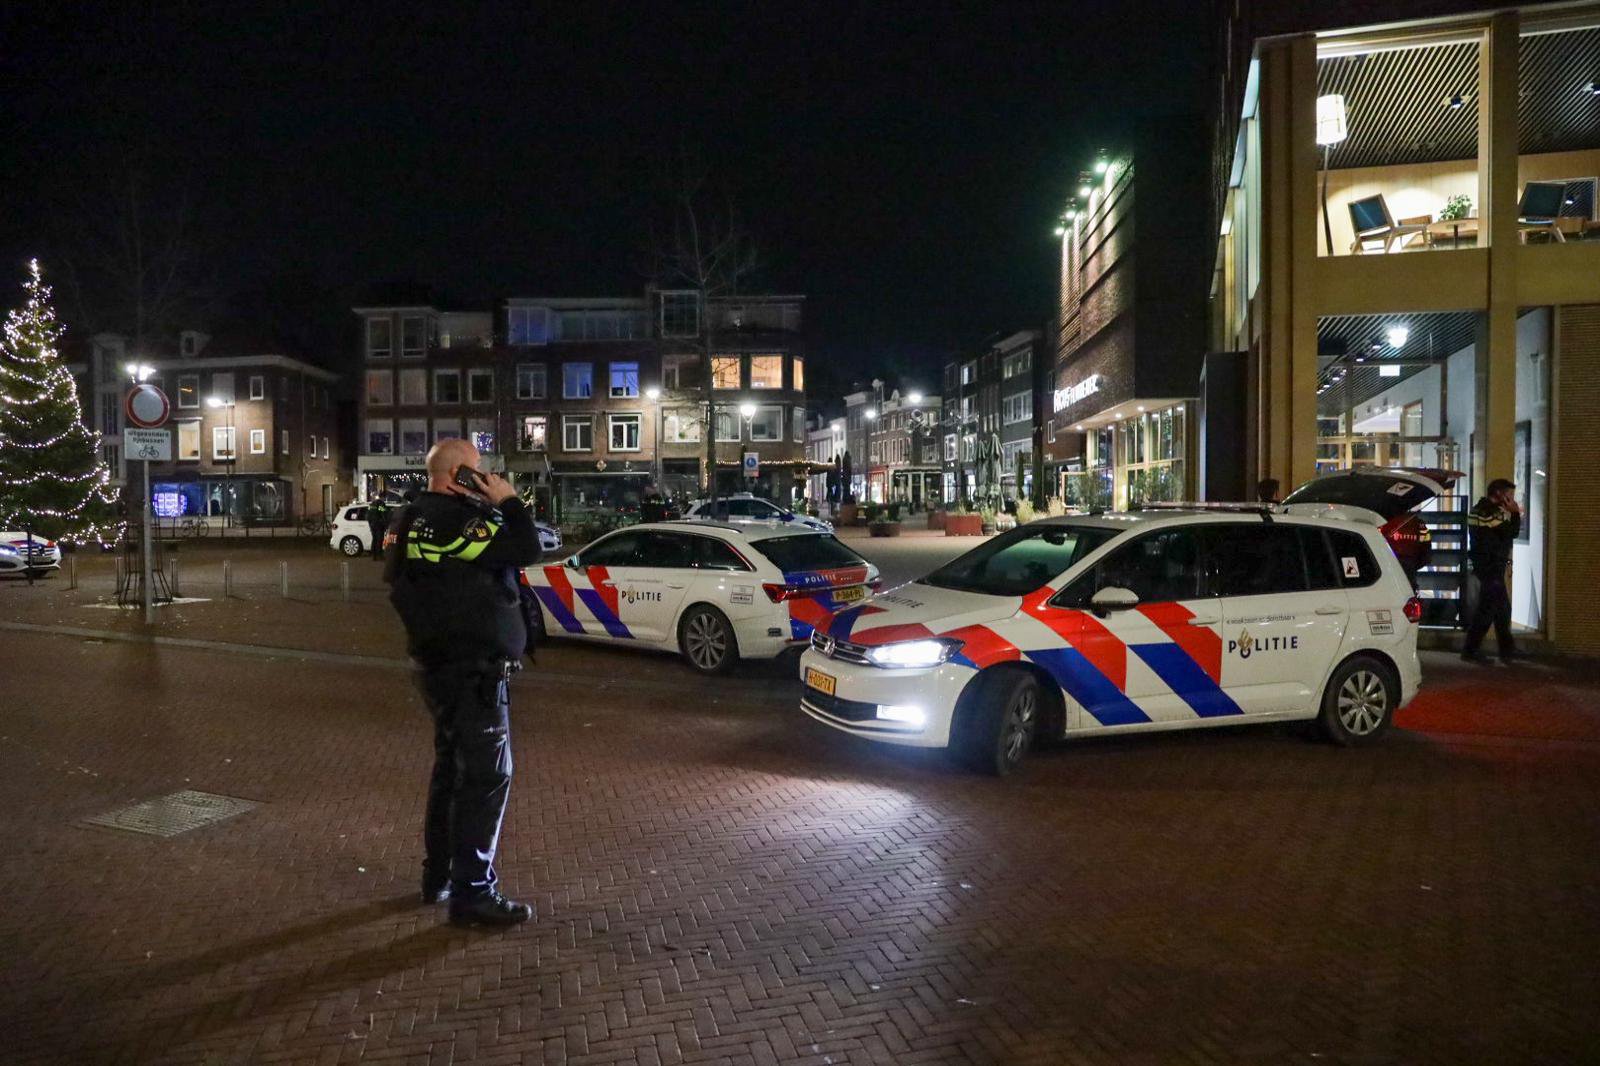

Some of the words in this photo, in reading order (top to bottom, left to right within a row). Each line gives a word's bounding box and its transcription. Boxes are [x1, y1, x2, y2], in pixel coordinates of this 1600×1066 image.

[804, 573, 837, 584] POLITIE
[621, 590, 662, 604] POLITIE
[1228, 636, 1298, 659] POLITIE
